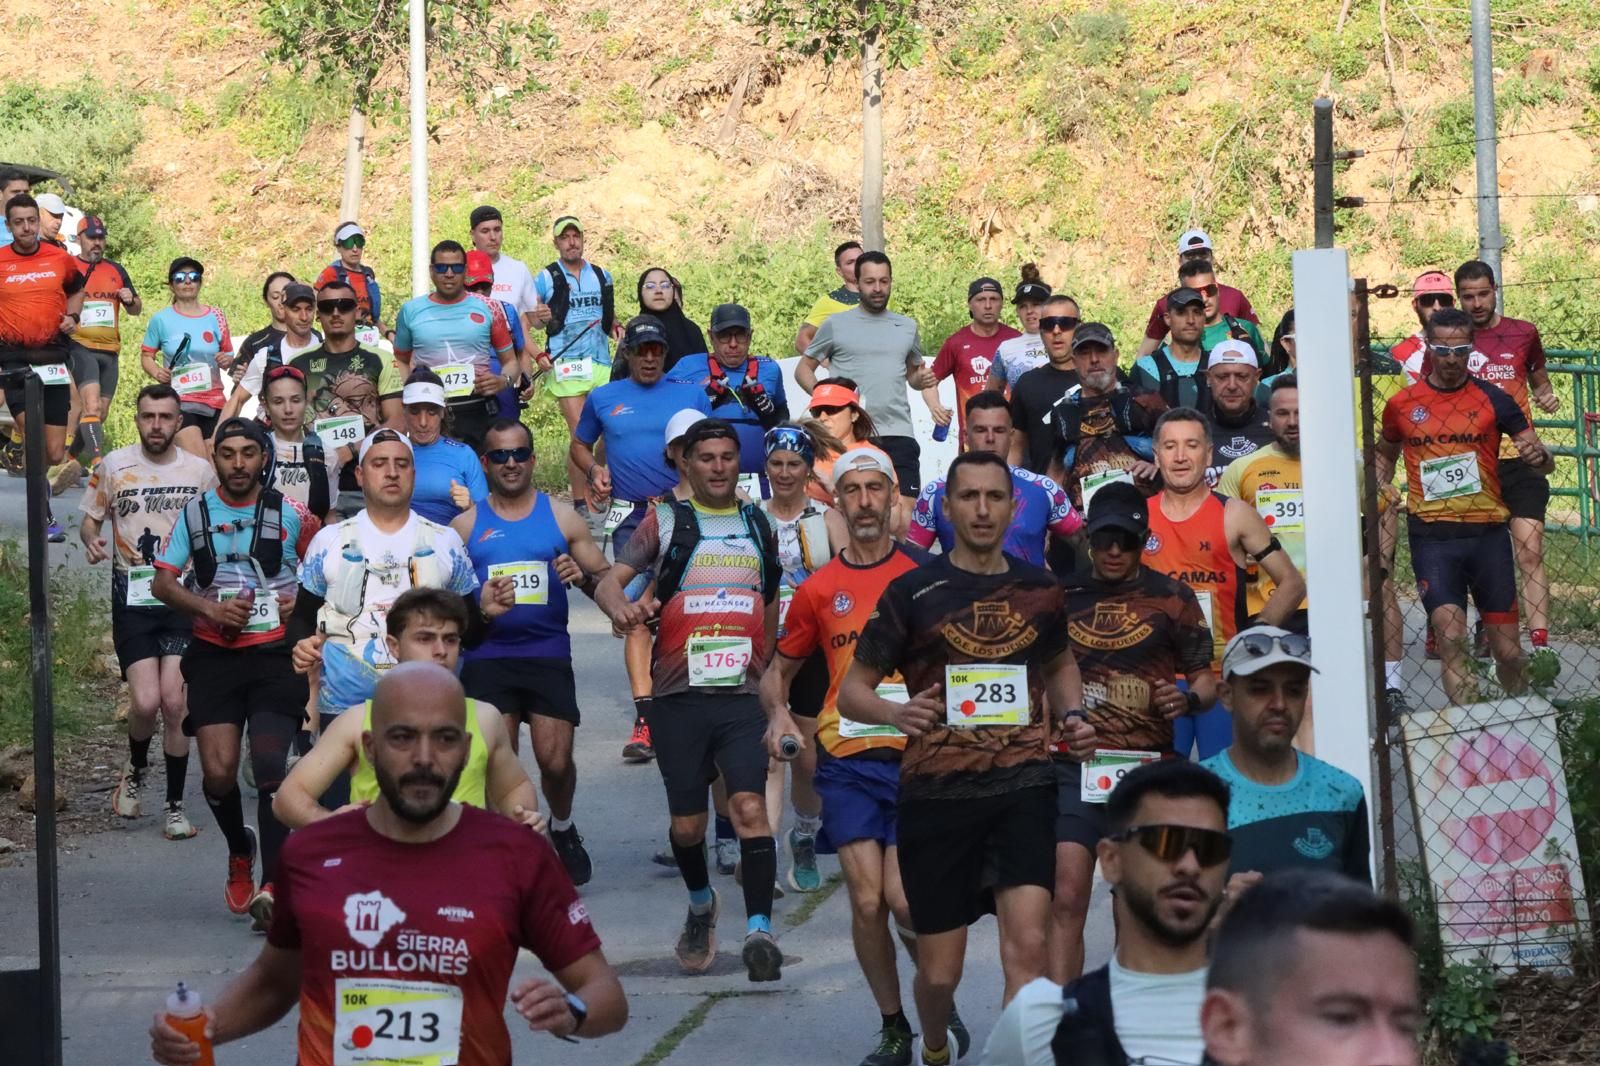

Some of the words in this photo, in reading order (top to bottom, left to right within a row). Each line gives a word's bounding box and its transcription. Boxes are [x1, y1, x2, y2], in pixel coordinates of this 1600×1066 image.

[95, 309, 107, 317] 57
[47, 367, 58, 375] 97
[570, 364, 584, 372] 98
[444, 373, 469, 385] 473
[333, 428, 357, 440] 148
[1445, 468, 1464, 483] 59
[117, 489, 139, 499] LOS
[141, 486, 198, 496] FUERTES
[695, 553, 720, 568] LOS
[972, 645, 994, 657] LOS
[703, 652, 749, 668] 176-2
[951, 675, 969, 683] 10K
[974, 683, 1017, 704] 283
[396, 934, 469, 956] SIERRA
[331, 950, 468, 976] BULLONES
[343, 994, 368, 1005] 10K
[374, 1008, 440, 1043] 213
